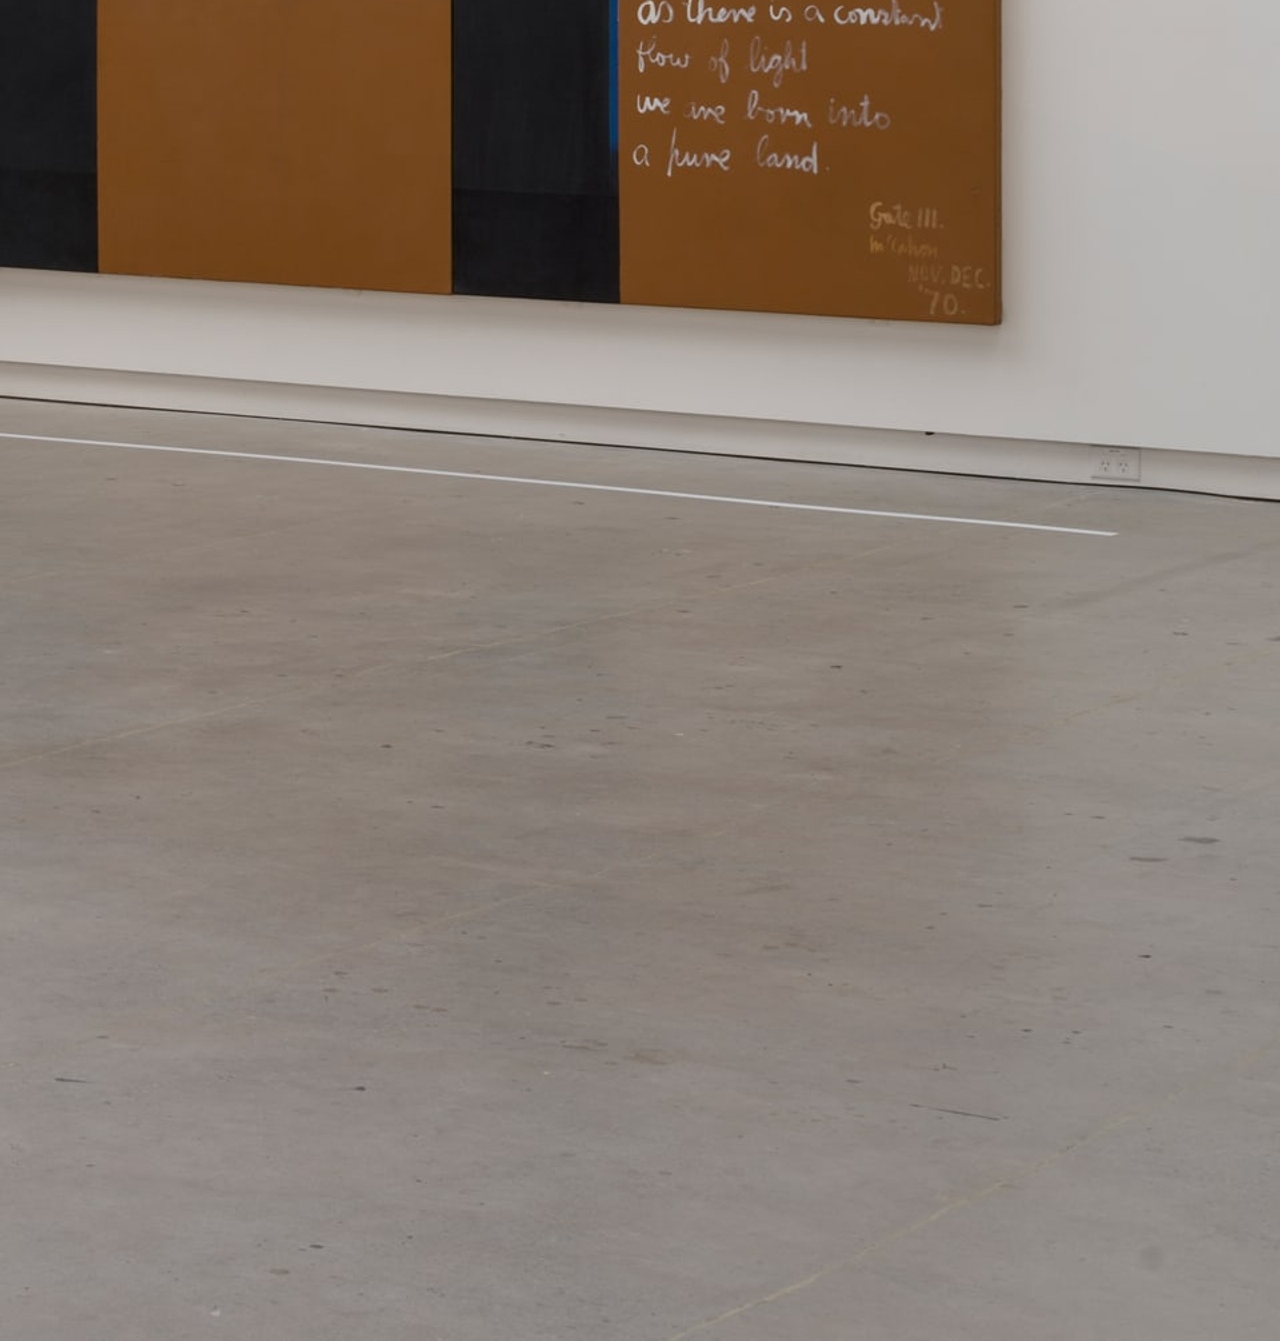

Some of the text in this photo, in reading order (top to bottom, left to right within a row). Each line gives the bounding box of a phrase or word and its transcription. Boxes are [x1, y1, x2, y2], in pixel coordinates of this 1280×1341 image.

[637, 0, 674, 26] as
[768, 0, 793, 23] is
[803, 4, 825, 24] a
[636, 35, 808, 88] flow of light
[637, 89, 892, 130] we are born into
[632, 127, 831, 177] a pure land.
[869, 201, 913, 230] Gate
